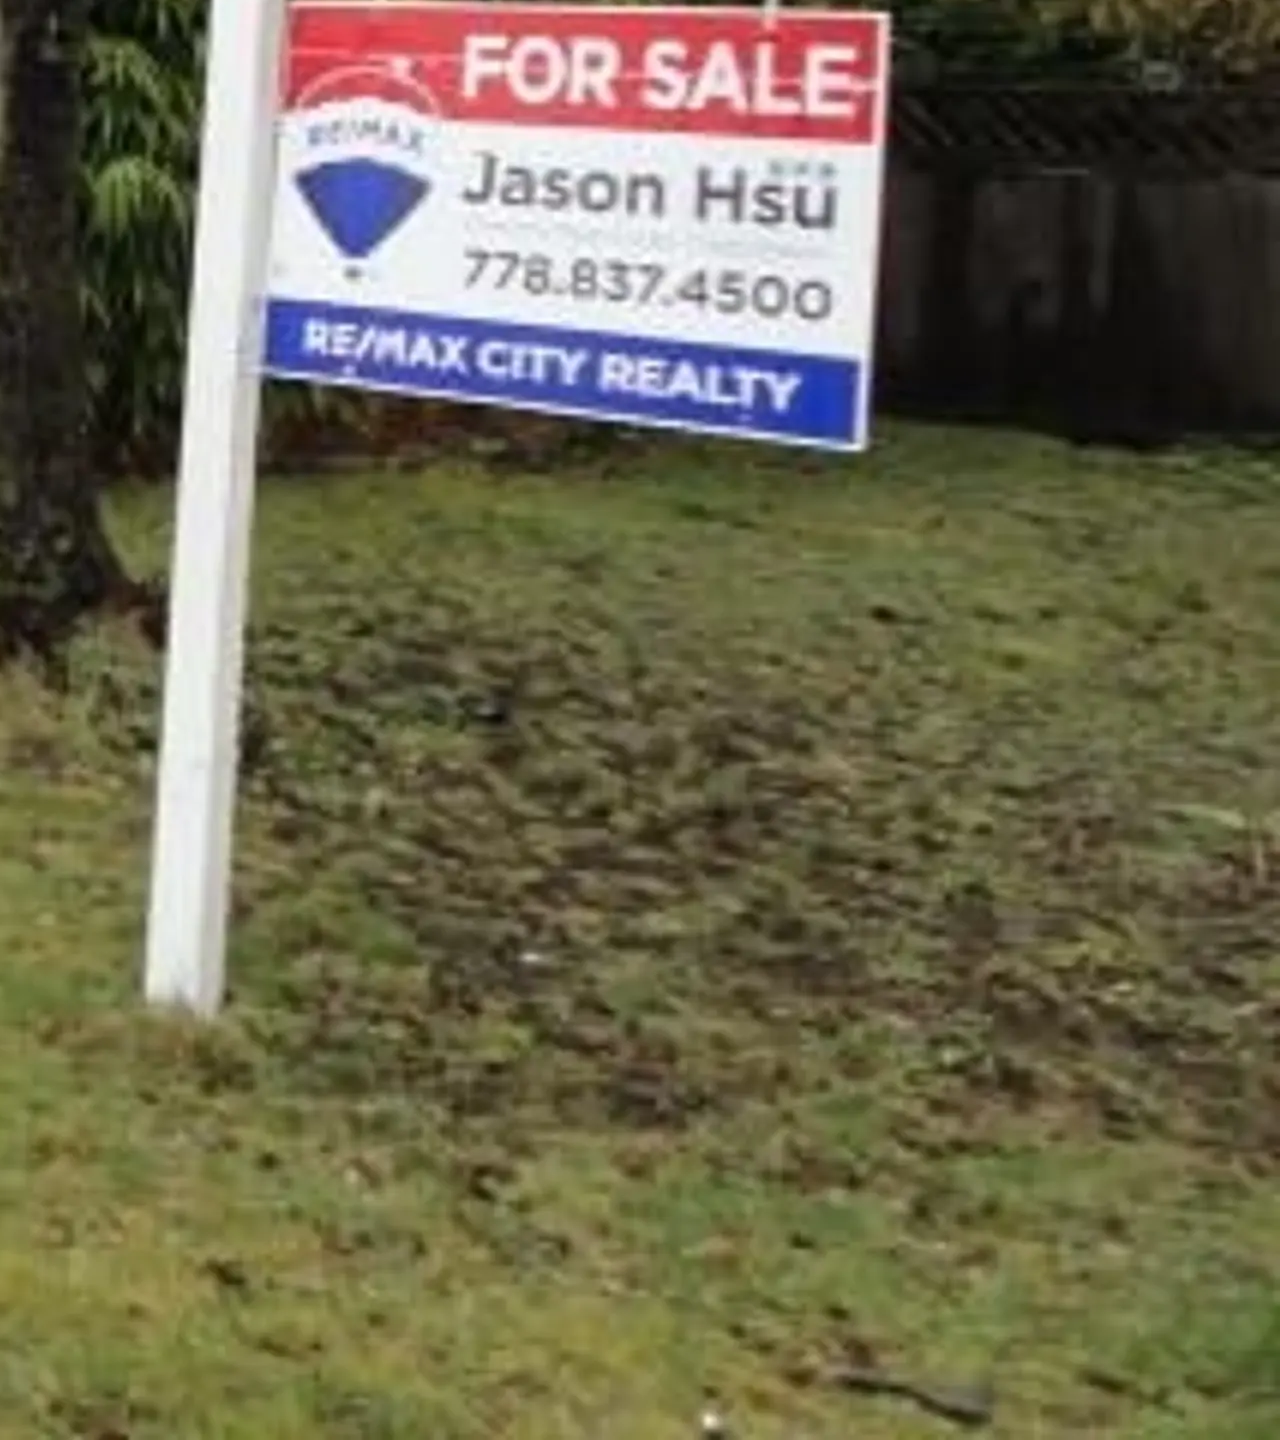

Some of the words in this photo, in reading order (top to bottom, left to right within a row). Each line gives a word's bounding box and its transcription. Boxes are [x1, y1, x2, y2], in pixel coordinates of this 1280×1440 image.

[462, 34, 621, 108] FOR
[643, 40, 858, 117] SALE
[307, 118, 424, 155] RE/MAX
[462, 150, 667, 218] Jason
[696, 165, 838, 230] Hsu
[463, 249, 834, 322] 778.837.4500
[301, 318, 468, 373] RE/MAX
[476, 340, 587, 386] CITY
[599, 351, 802, 412] REALTY
